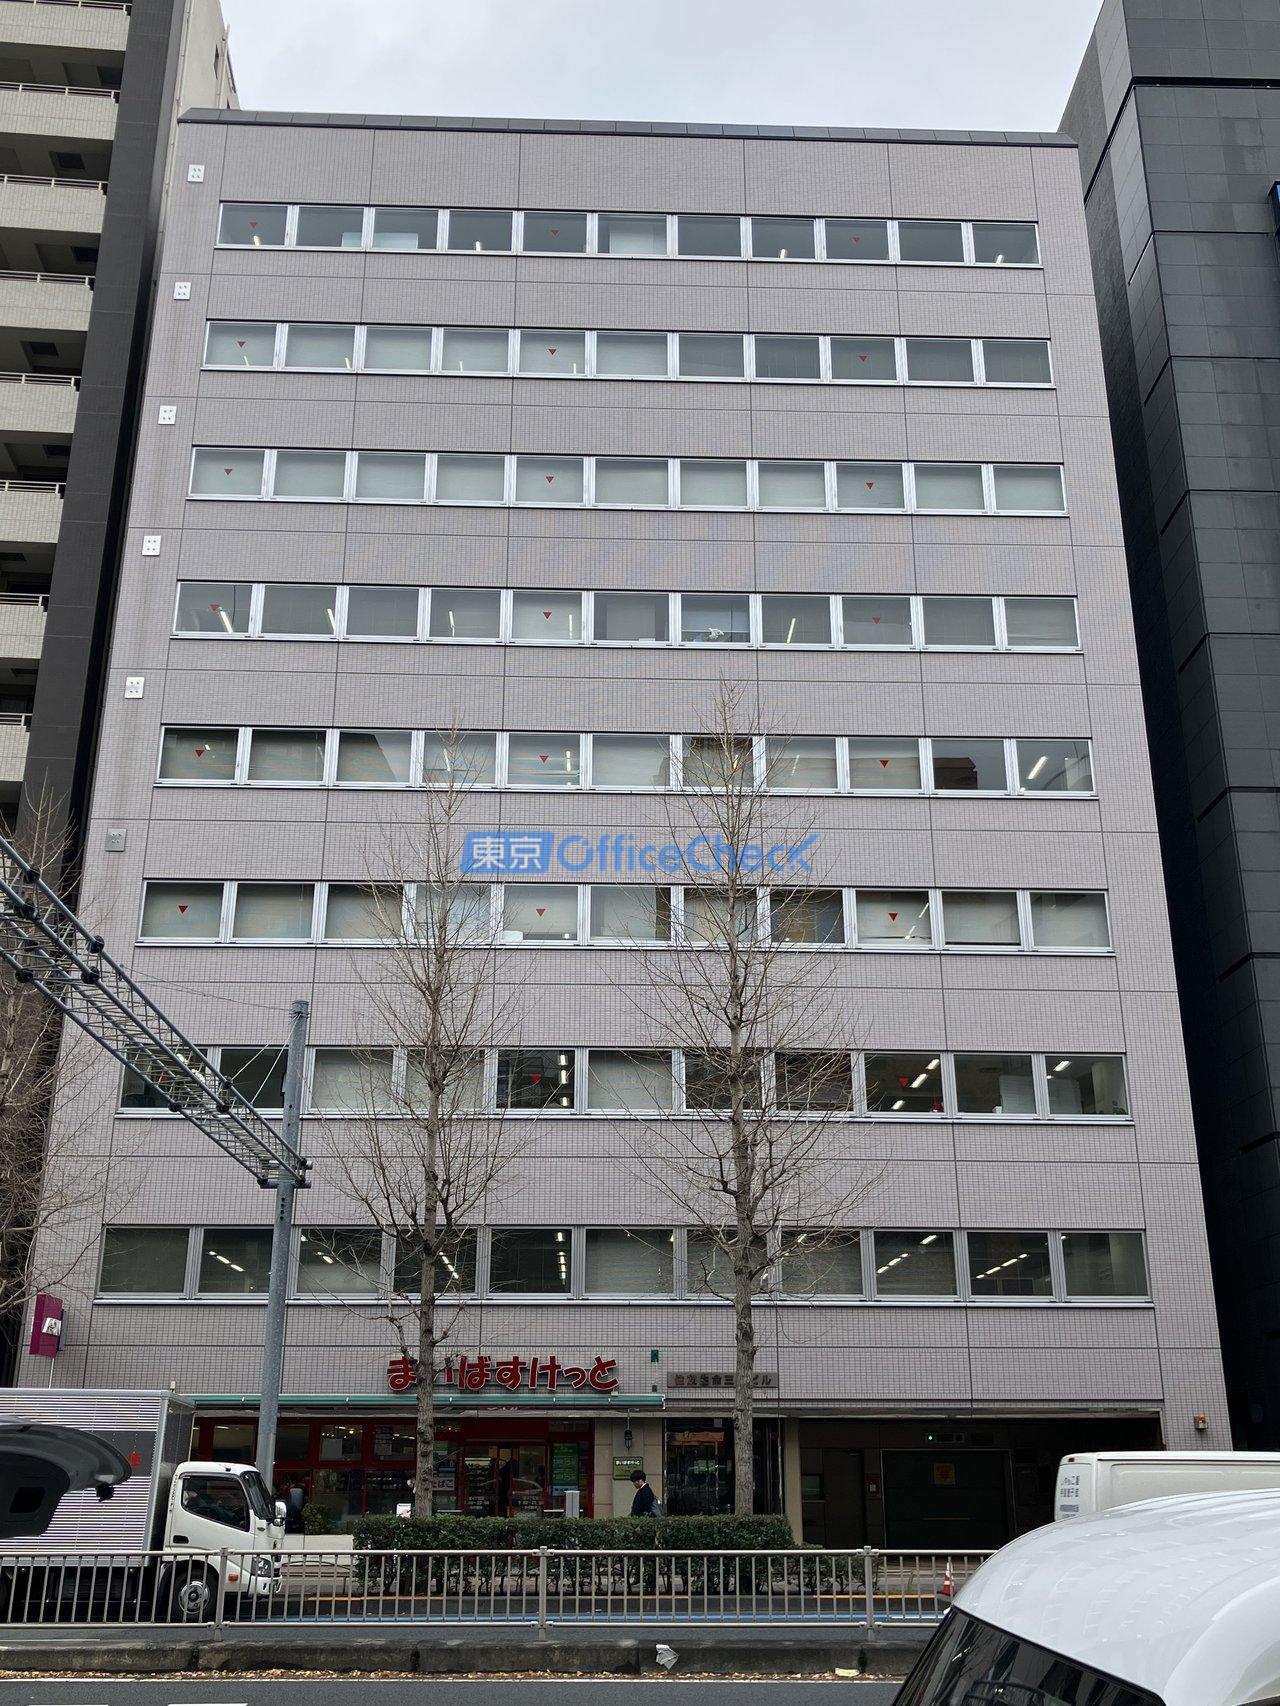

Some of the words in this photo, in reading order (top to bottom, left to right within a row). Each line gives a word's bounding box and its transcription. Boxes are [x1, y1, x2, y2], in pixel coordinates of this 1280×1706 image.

[675, 1374, 771, 1386] 住友生命三ビル
